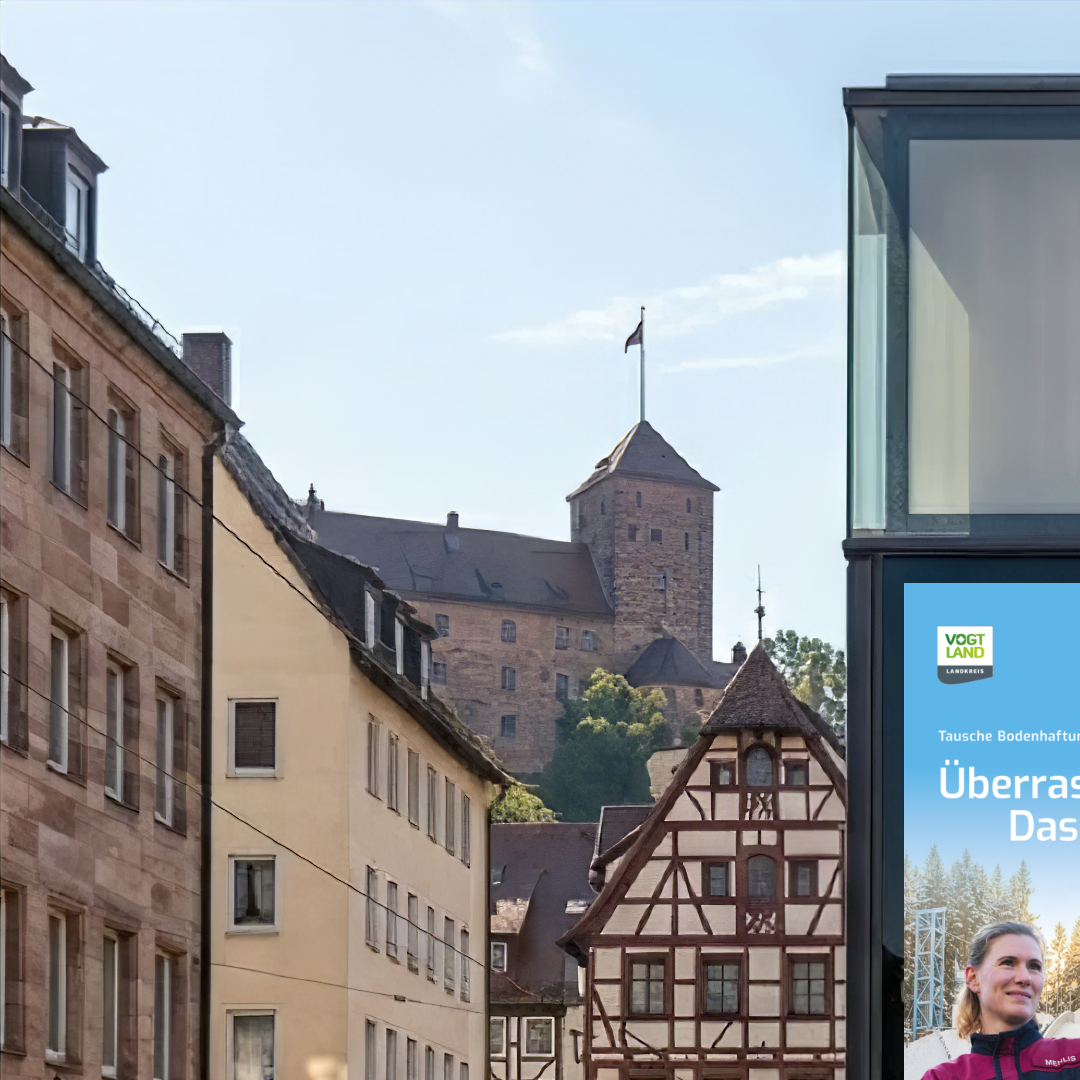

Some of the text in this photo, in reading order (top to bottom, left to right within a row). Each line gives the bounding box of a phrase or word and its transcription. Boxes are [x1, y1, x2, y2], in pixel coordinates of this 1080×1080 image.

[945, 633, 985, 646] VOGT
[946, 646, 985, 659] LAND
[938, 730, 993, 742] Tausche
[1010, 809, 1078, 842] Das
[1045, 1055, 1076, 1066] MEHLIS
